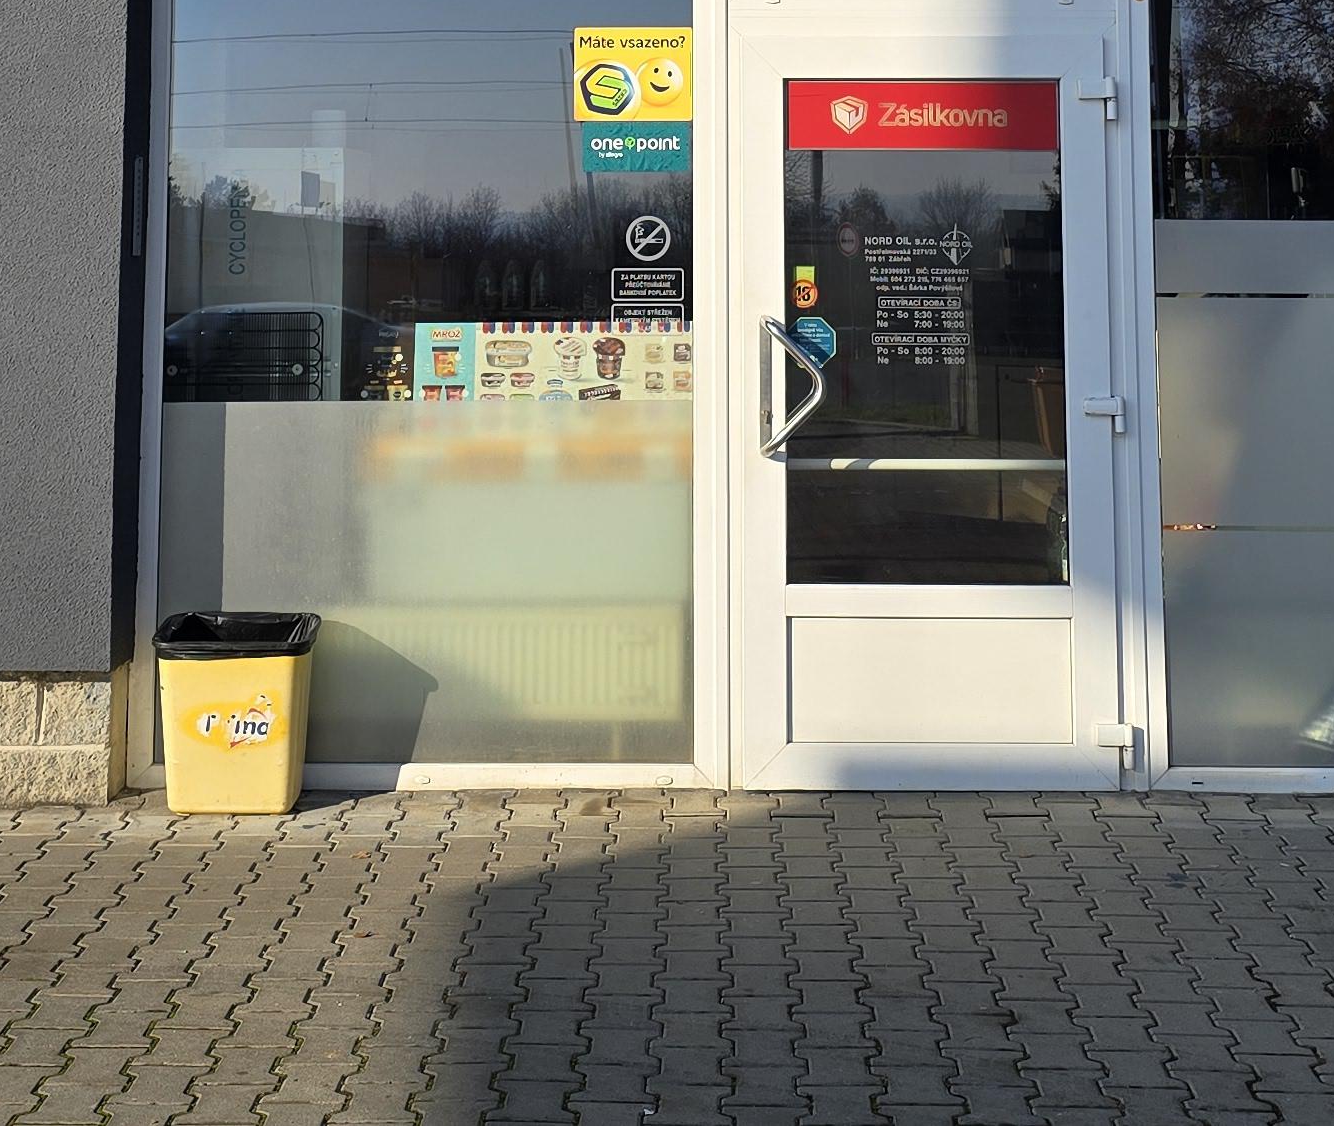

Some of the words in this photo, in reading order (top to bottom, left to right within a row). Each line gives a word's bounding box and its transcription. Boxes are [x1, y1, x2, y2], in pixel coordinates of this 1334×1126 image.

[579, 35, 615, 49] Máte
[620, 35, 686, 49] vsazeno?
[877, 103, 1008, 128] Zásilkovna
[864, 236, 893, 246] NORD
[895, 236, 912, 246] OIL
[914, 237, 938, 246] s.r.o.
[880, 298, 922, 307] OTEVÍRACÍ
[923, 299, 945, 307] DOBA
[876, 310, 888, 319] Po
[896, 310, 909, 319] So
[940, 310, 965, 319] 20:00
[876, 319, 889, 328] Ne
[913, 320, 933, 329] 7:00
[874, 334, 915, 343] OTEVÍRACÍ
[940, 335, 967, 343] MYČKY
[876, 346, 889, 355] Po
[897, 346, 910, 355] So
[914, 346, 933, 355] 8:00
[941, 346, 965, 355] 20:00
[877, 356, 890, 365] Ne
[914, 356, 934, 365] 8:00
